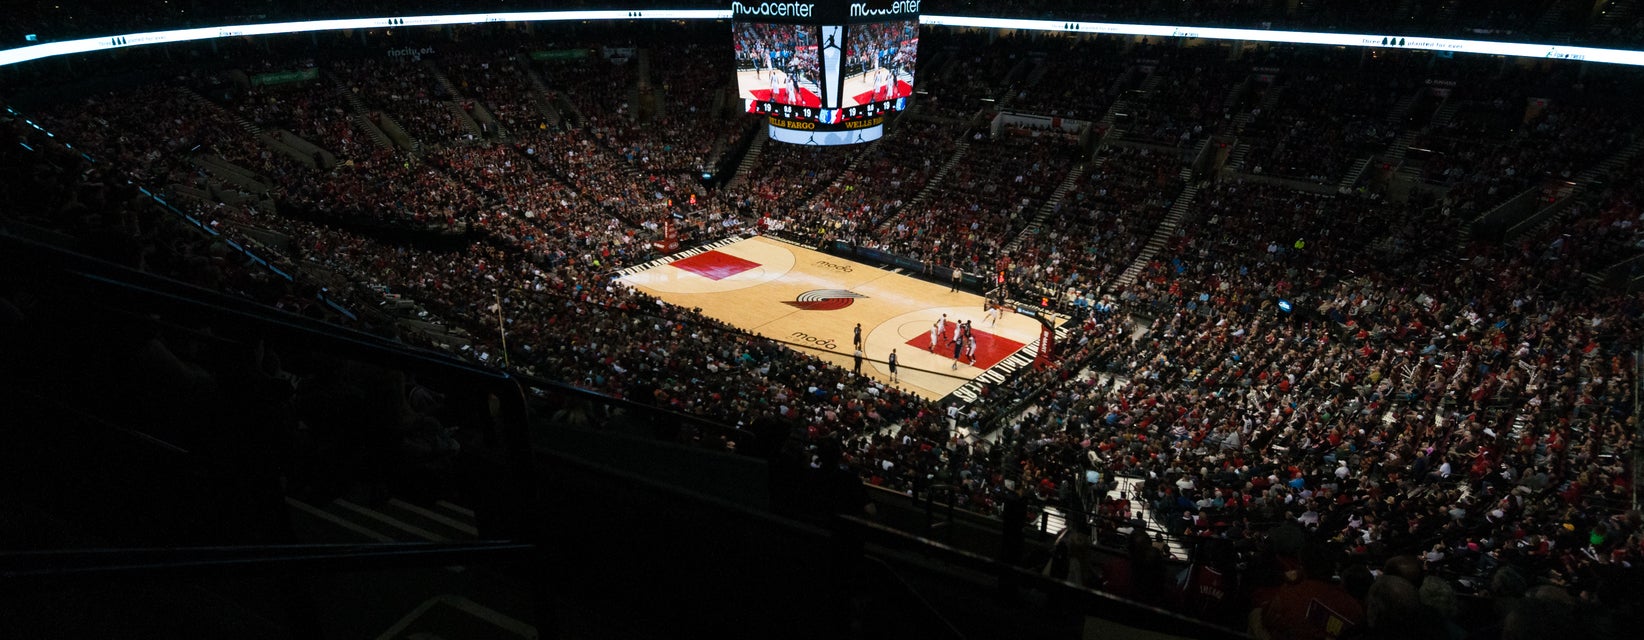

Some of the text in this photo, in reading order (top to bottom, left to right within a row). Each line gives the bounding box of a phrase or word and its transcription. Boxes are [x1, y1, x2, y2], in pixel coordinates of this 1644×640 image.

[763, 102, 772, 112] 19
[803, 108, 812, 118] 19
[787, 120, 815, 130] FARGO
[845, 119, 873, 129] WELLS
